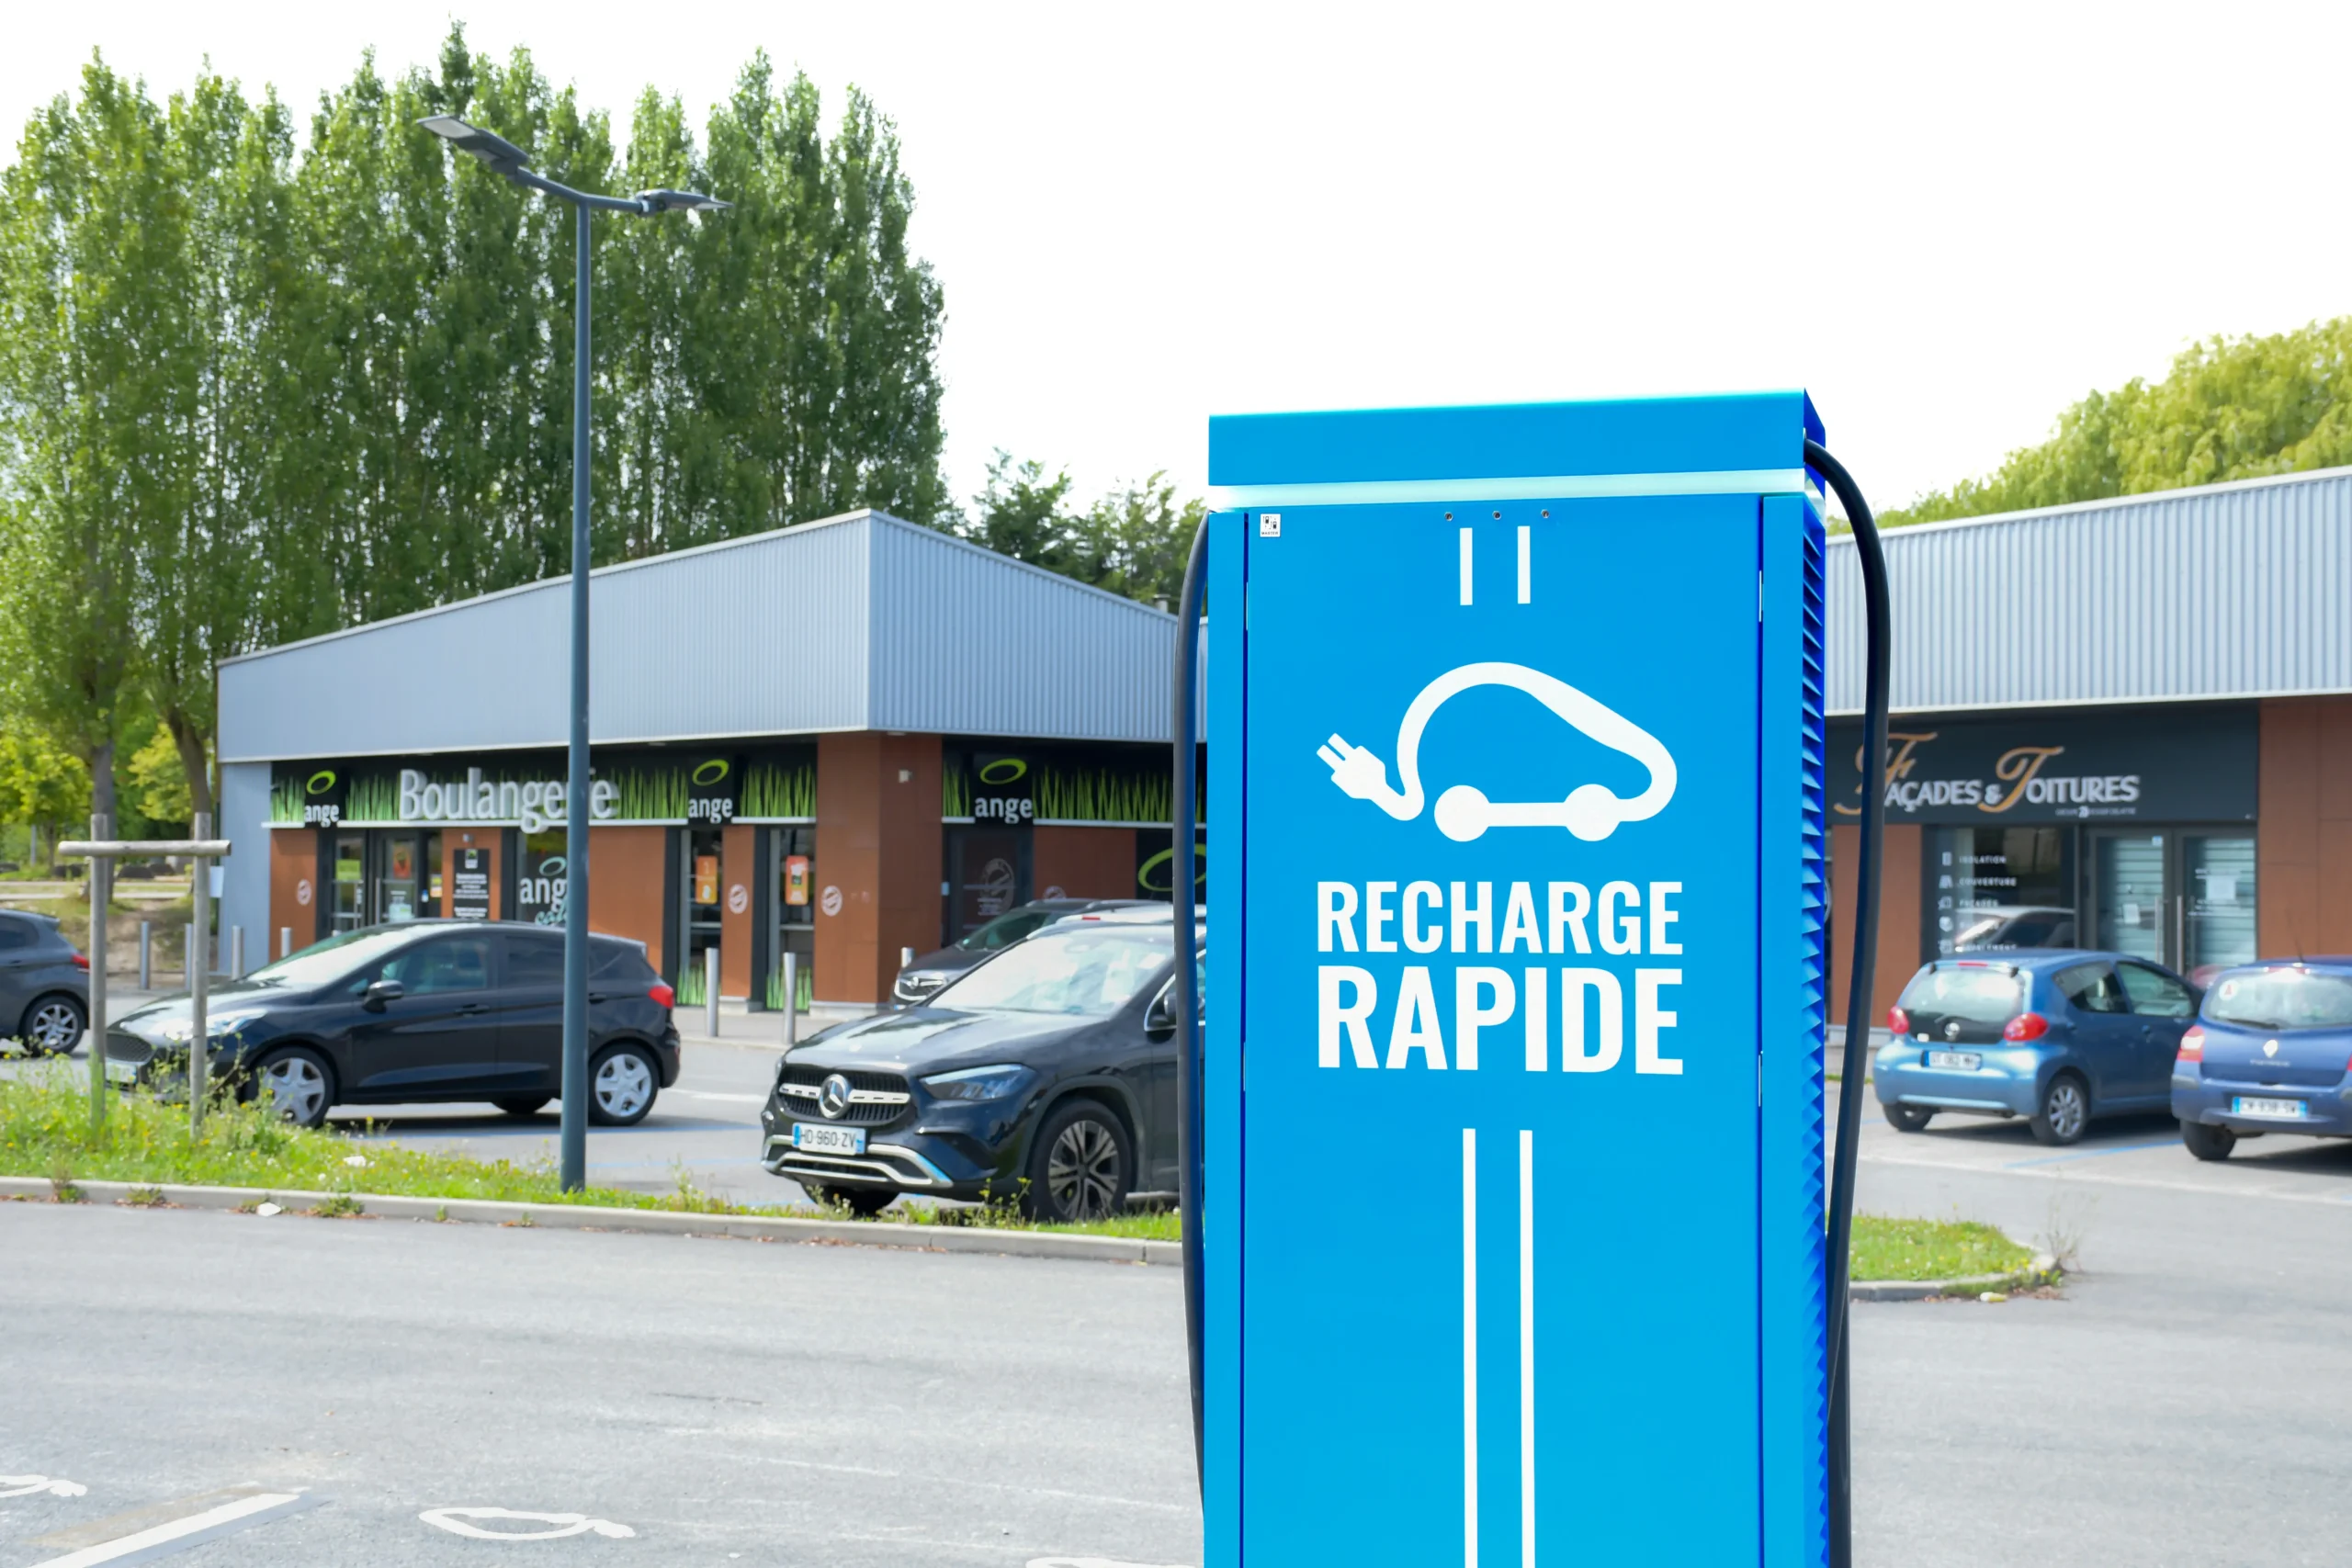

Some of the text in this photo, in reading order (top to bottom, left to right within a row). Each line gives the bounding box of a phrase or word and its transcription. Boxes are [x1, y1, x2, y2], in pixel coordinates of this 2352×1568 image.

[1978, 747, 2142, 813] TOITURES
[1984, 784, 2003, 805] &
[399, 767, 620, 834] Boulangee
[688, 797, 733, 824] ange
[976, 797, 1033, 824] ange
[304, 805, 339, 828] ange
[520, 877, 568, 913] ang
[1959, 877, 2017, 886] COUVERTURE
[1317, 880, 1683, 955] RECHARGE
[1317, 965, 1683, 1075] RAPIDE
